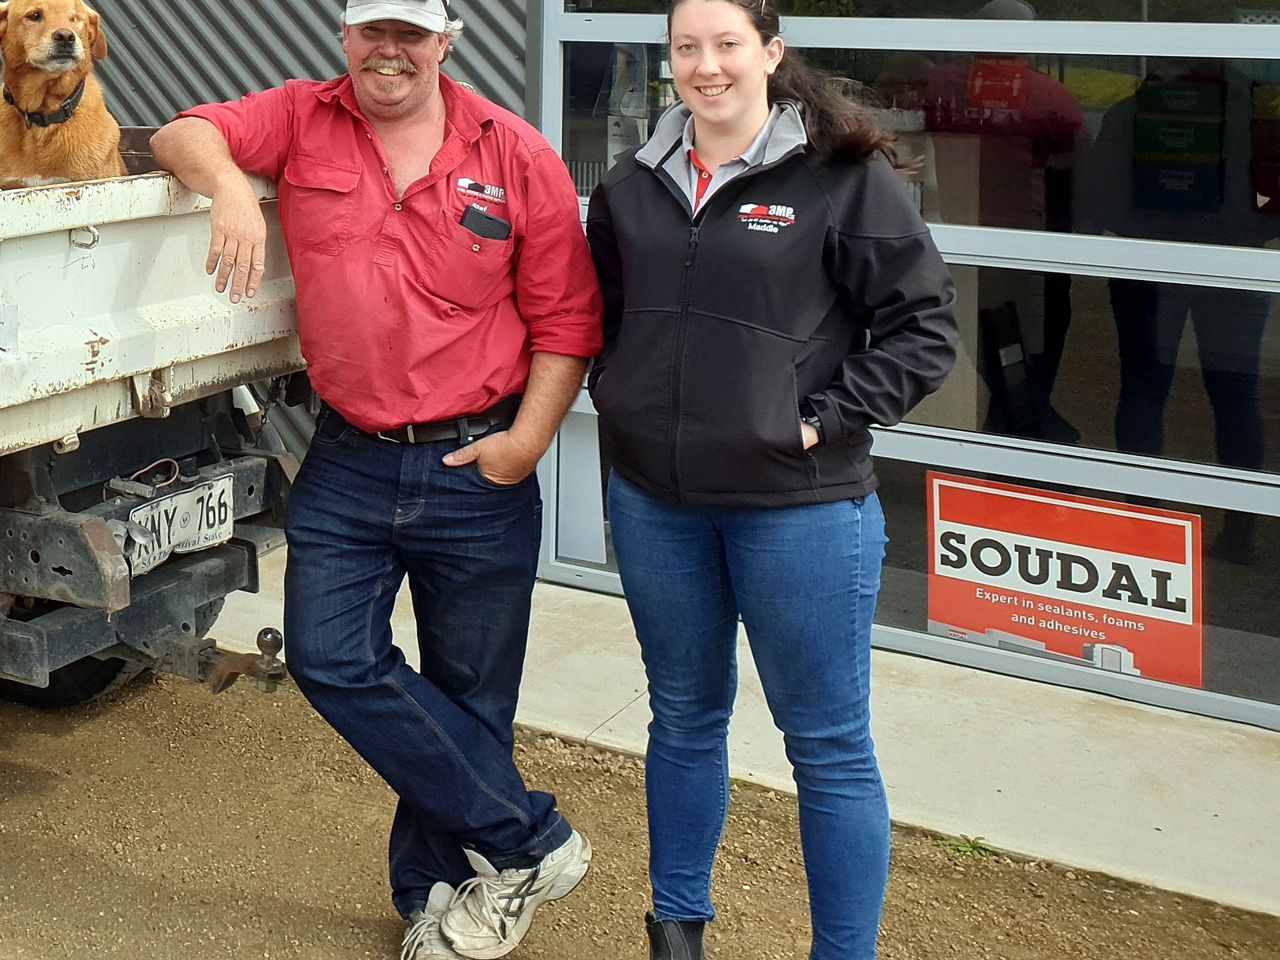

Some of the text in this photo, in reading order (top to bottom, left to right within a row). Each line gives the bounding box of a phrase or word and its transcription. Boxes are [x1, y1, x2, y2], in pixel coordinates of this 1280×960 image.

[484, 184, 505, 198] 3MP
[196, 488, 228, 533] 766
[939, 530, 1187, 614] SOUDAL
[975, 587, 1146, 632] Expert in sealants, foams
[1011, 613, 1107, 641] and adhesives
